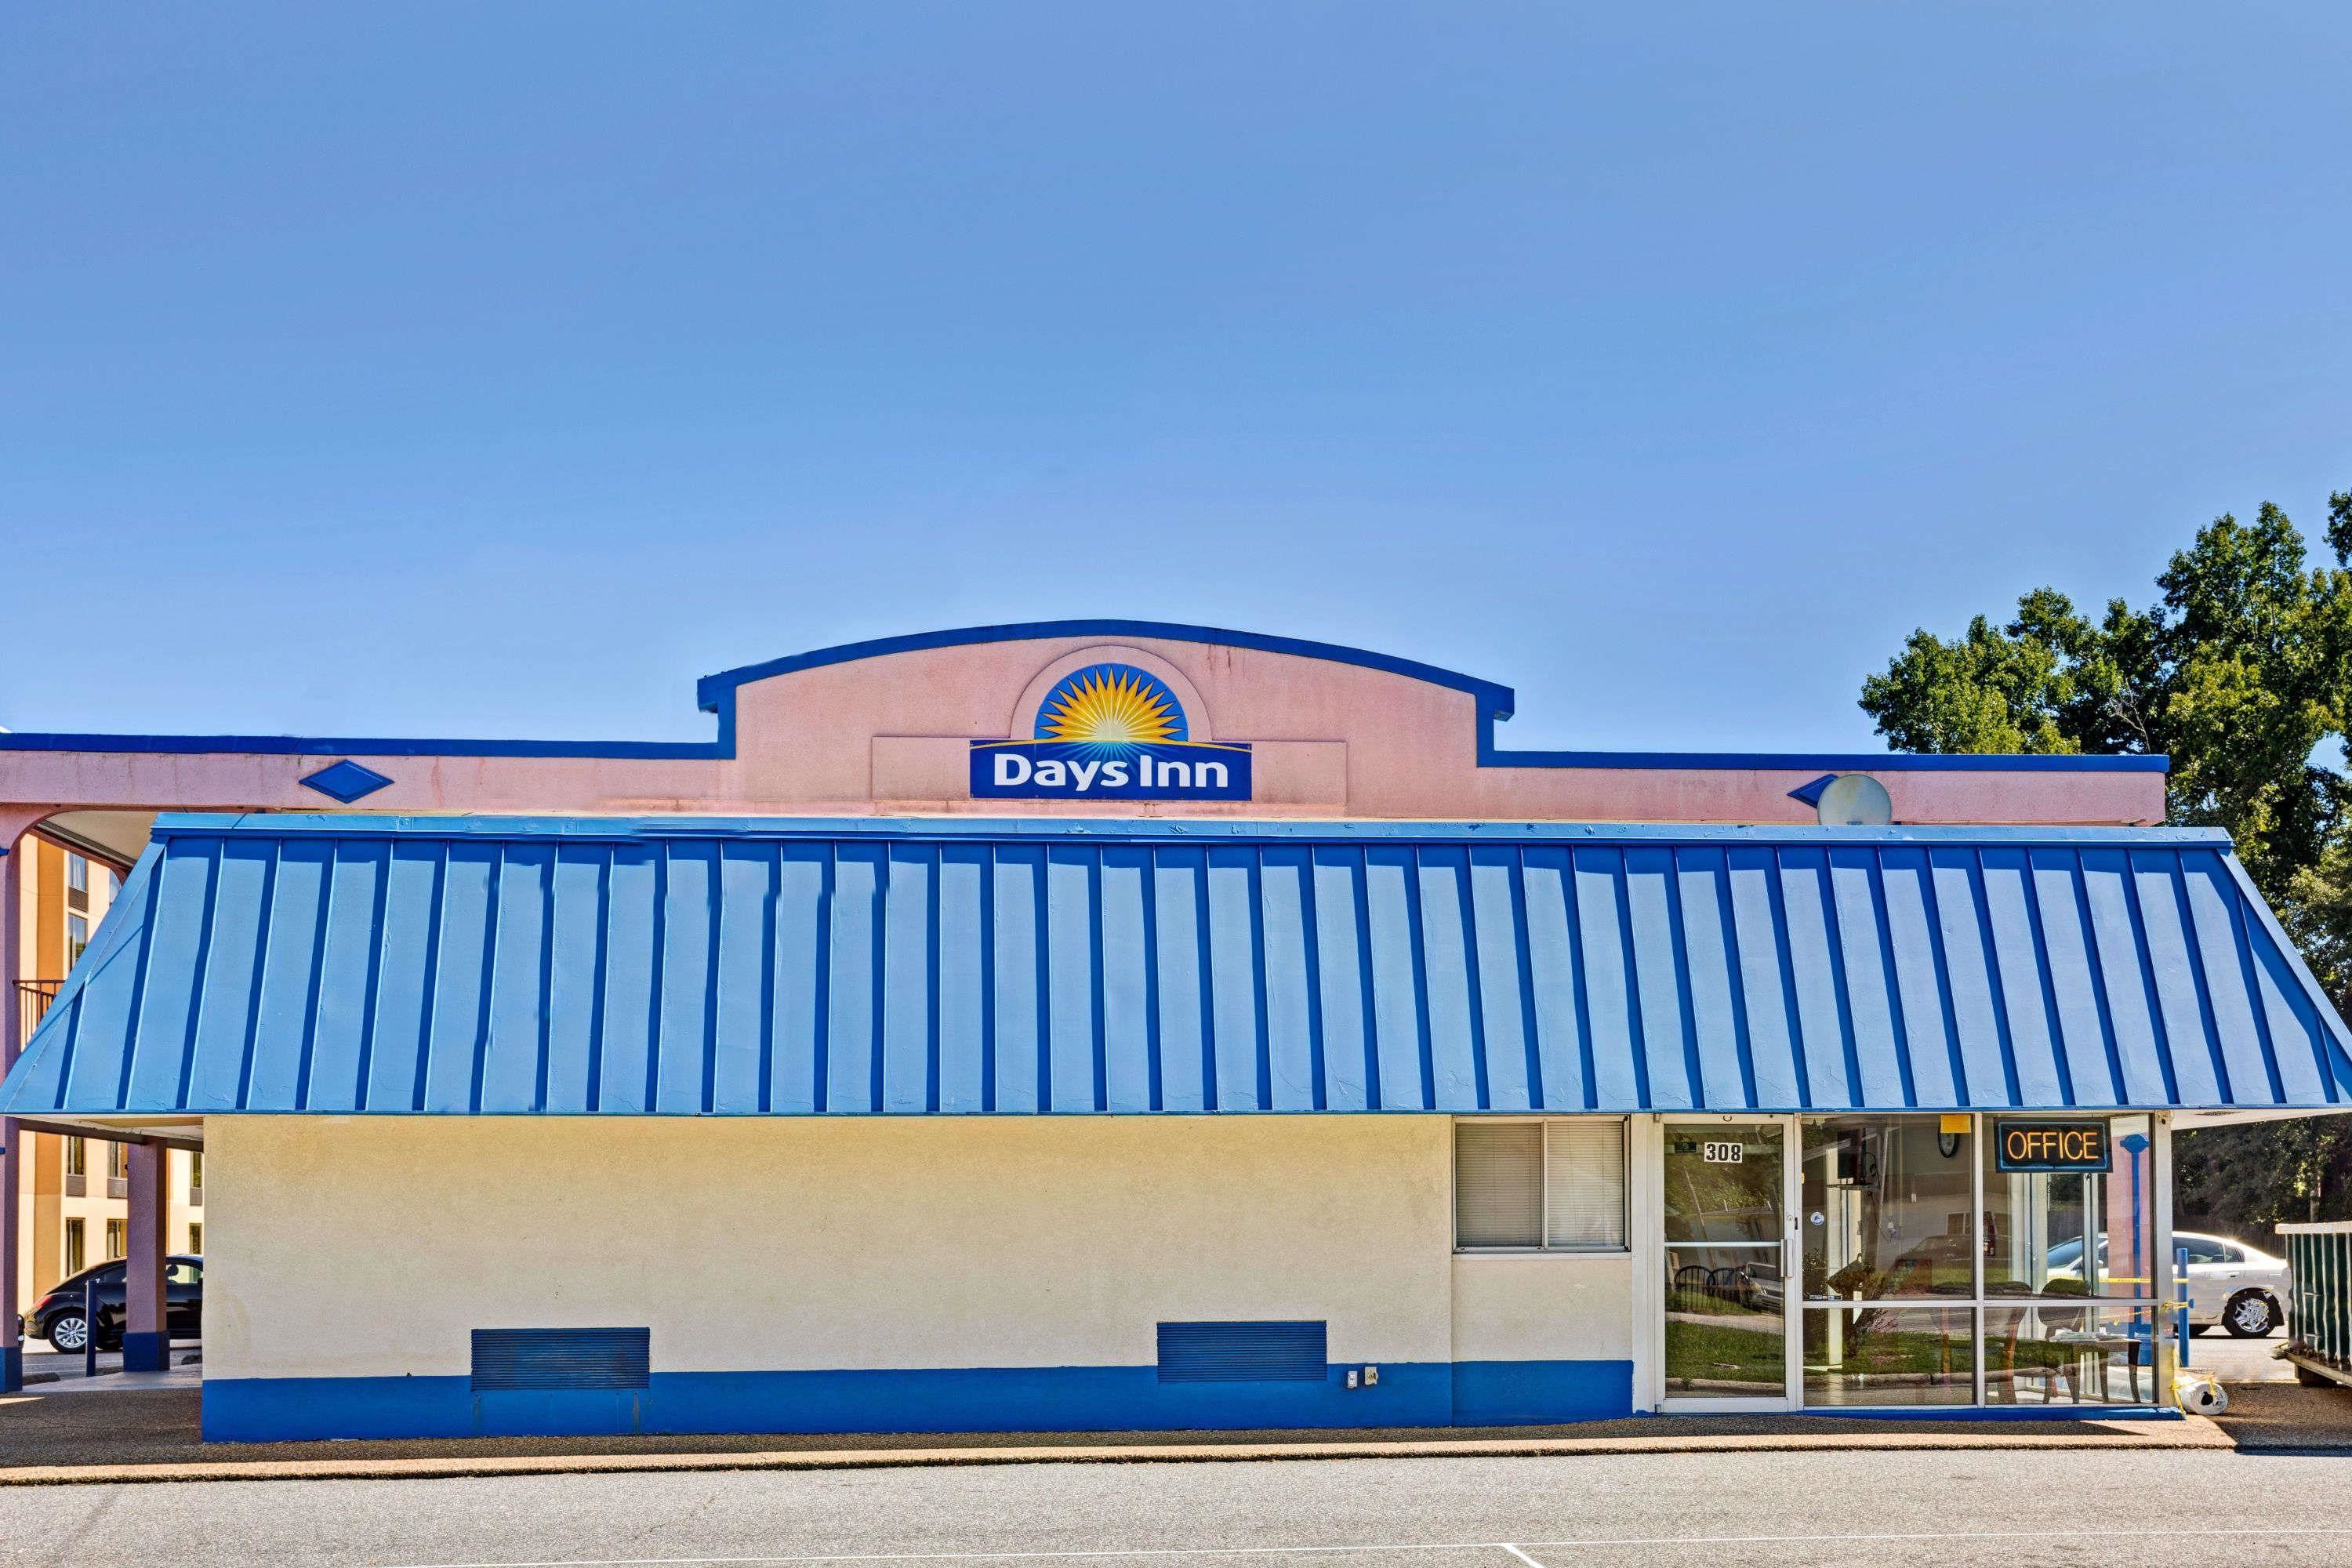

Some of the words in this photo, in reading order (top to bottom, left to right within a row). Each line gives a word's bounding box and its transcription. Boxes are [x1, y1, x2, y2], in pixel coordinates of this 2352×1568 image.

[994, 753, 1129, 792] Days
[1140, 755, 1229, 788] Inn
[1705, 1143, 1741, 1162] 308
[2007, 1131, 2100, 1160] OFFICE
